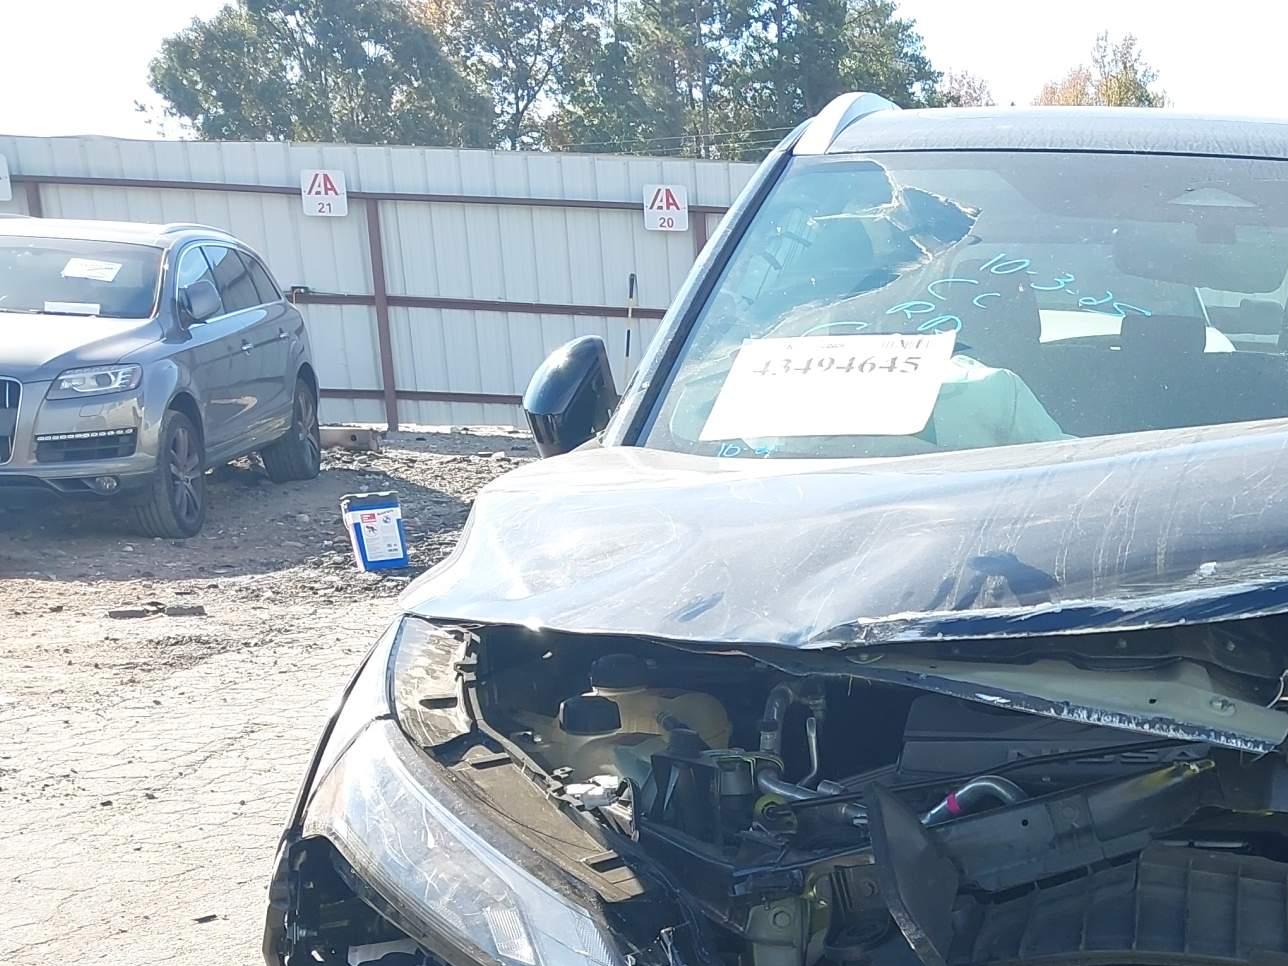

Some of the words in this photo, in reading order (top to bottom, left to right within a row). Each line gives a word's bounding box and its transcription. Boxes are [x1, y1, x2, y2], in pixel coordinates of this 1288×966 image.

[317, 202, 332, 214] 21
[659, 217, 674, 228] 20
[751, 355, 922, 377] 43494645
